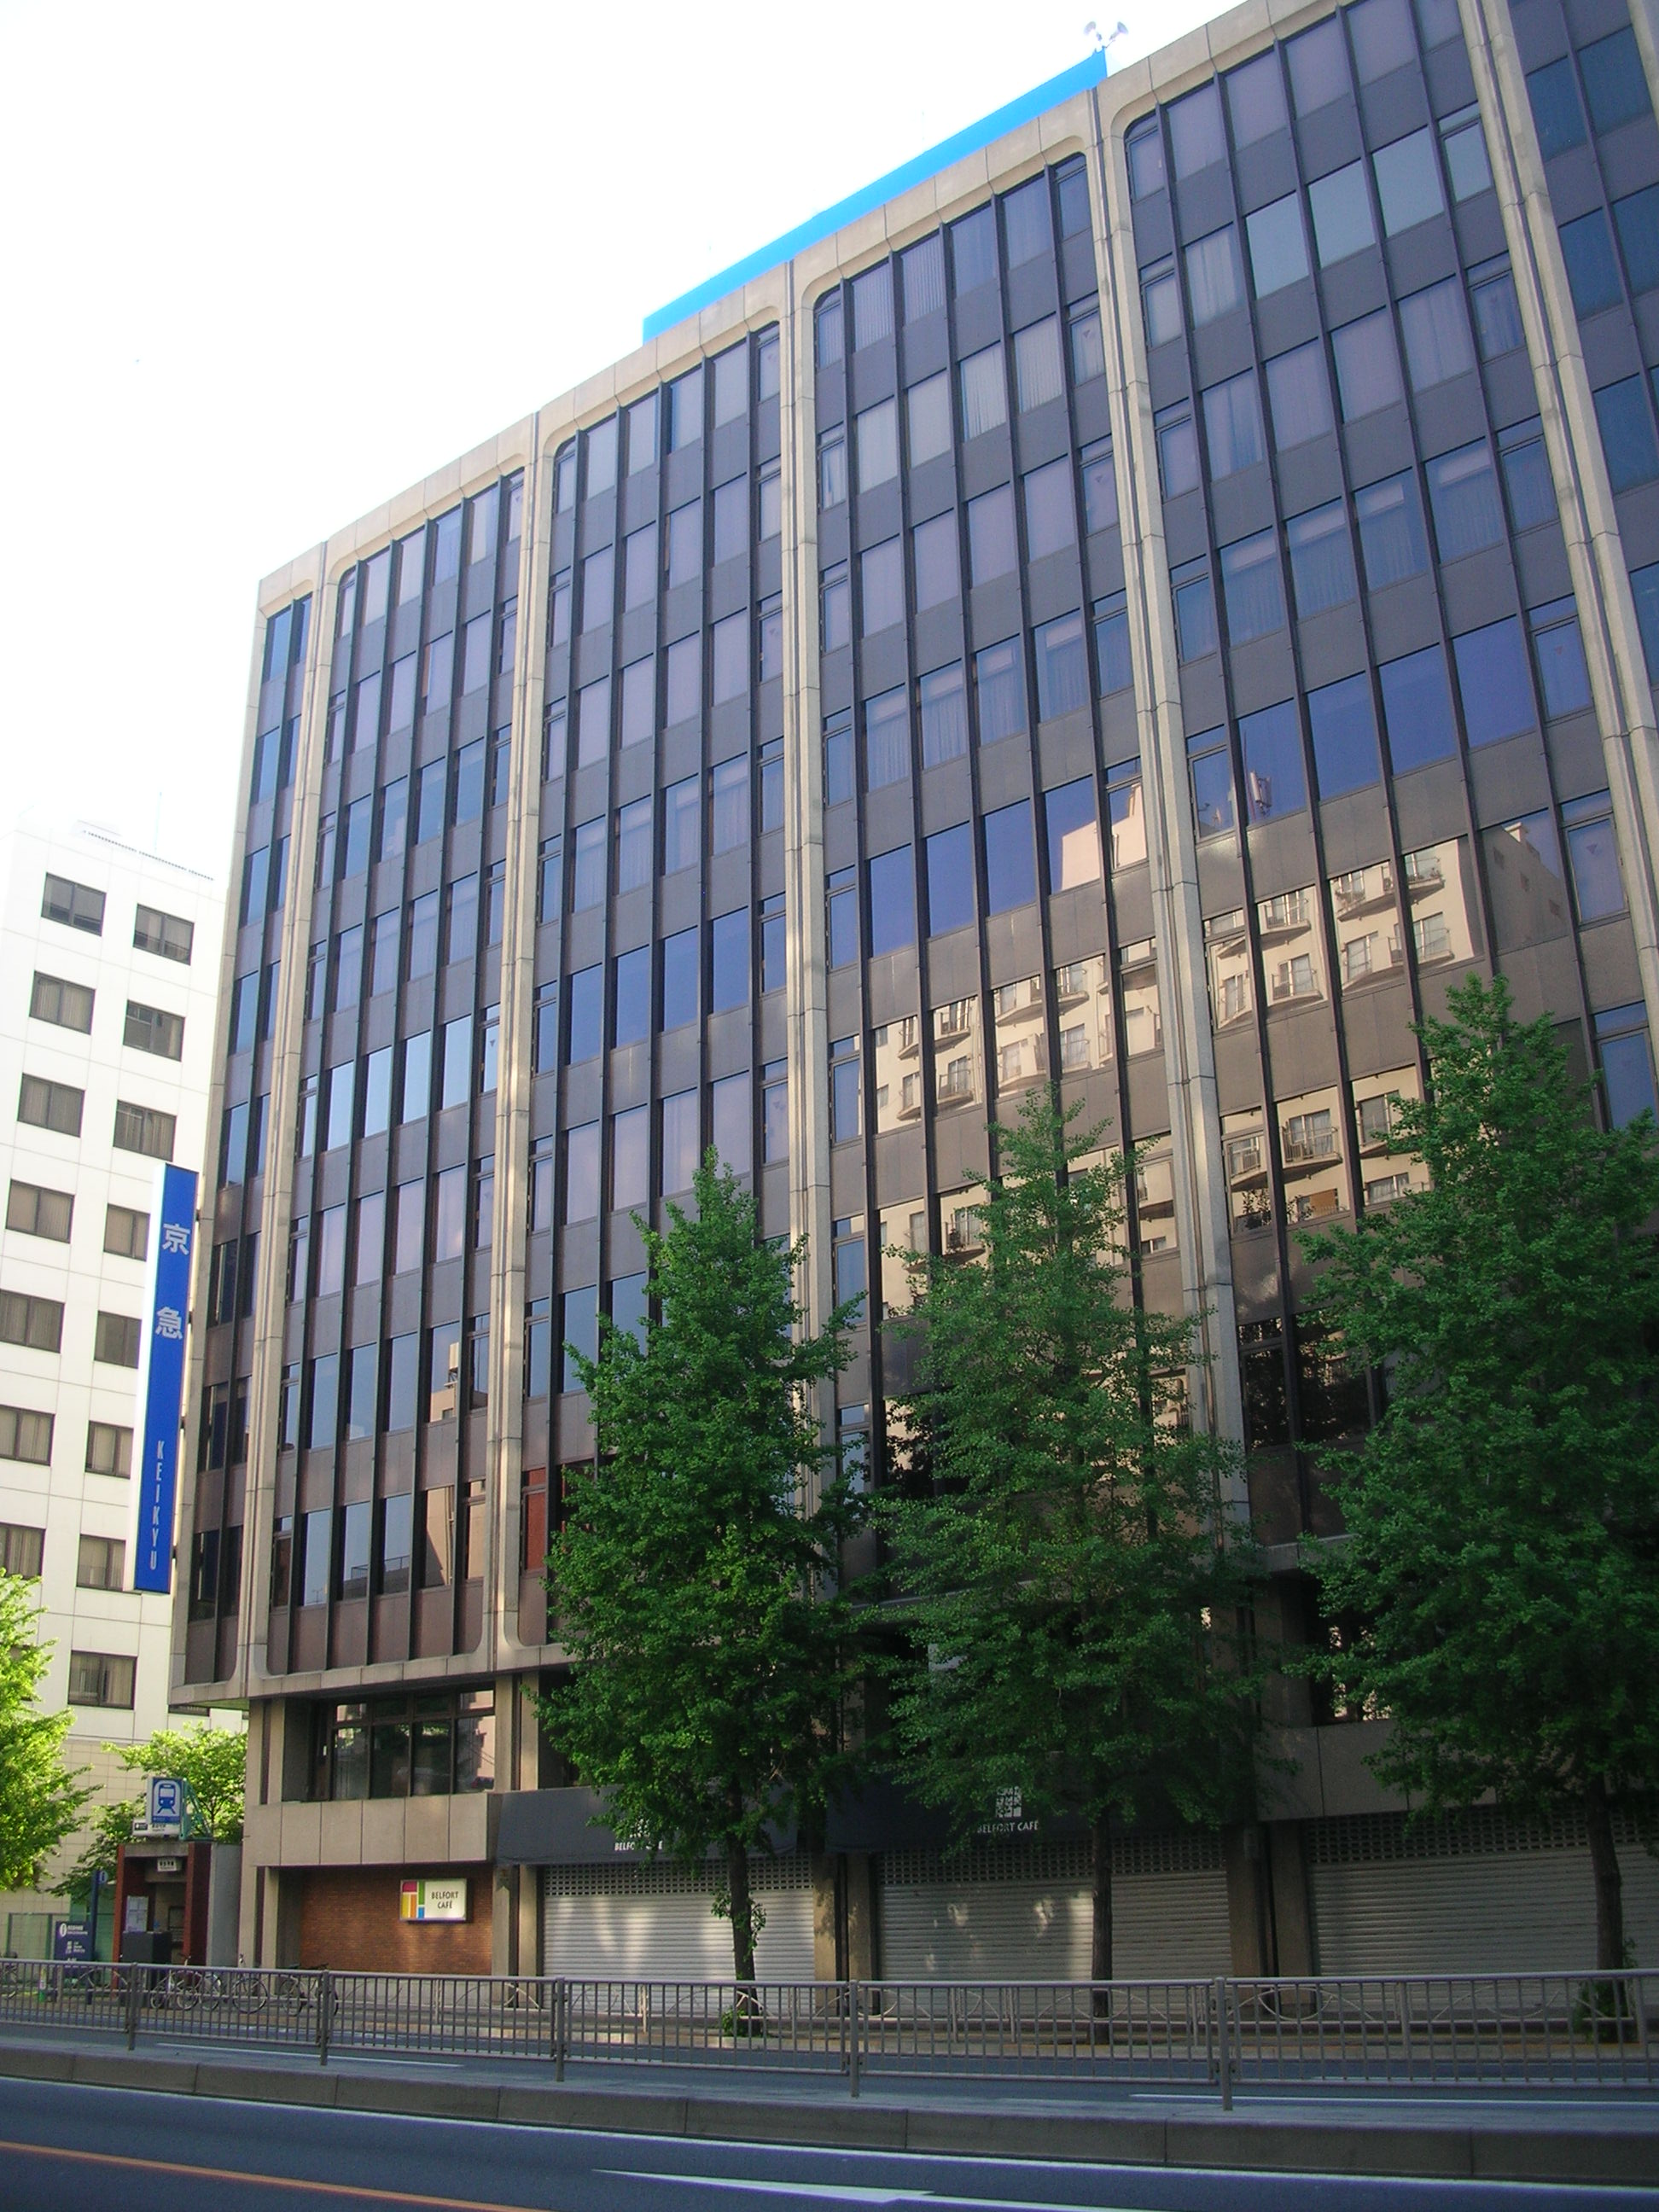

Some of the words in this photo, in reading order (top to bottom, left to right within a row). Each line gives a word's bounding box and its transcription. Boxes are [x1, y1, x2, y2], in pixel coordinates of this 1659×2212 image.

[154, 1223, 191, 1340] 京急
[150, 1440, 165, 1570] KEIKYU
[431, 1890, 459, 1900] BELFORT
[437, 1901, 453, 1909] CAFÉ
